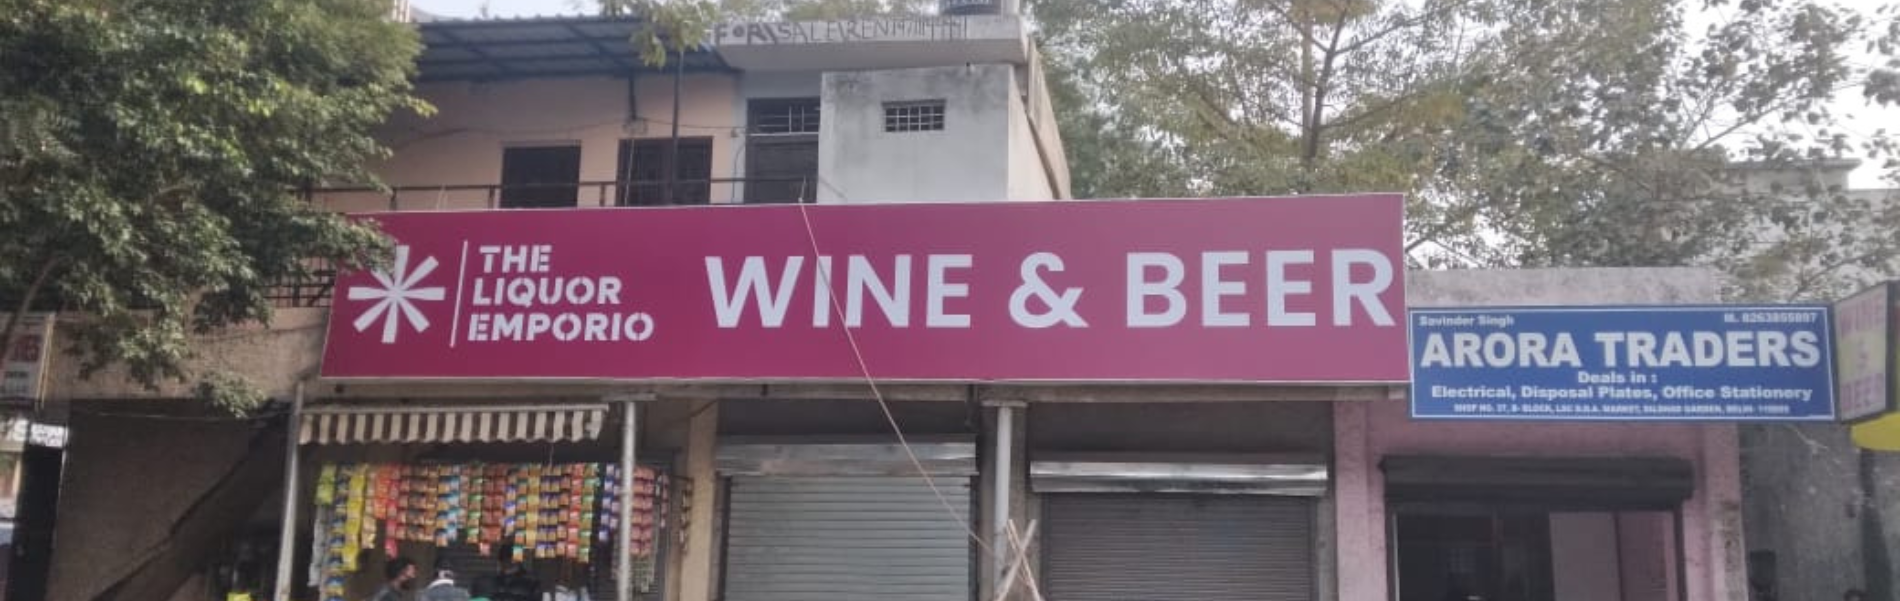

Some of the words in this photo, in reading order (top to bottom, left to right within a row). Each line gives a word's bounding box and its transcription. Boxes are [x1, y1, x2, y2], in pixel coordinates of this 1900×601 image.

[479, 245, 552, 273] THE
[473, 276, 622, 308] LIQUOR
[704, 254, 973, 328] WINE
[1008, 252, 1089, 328] &
[1126, 249, 1396, 327] BEER
[468, 312, 654, 341] EMPORIO
[1420, 332, 1582, 368] ARORA
[1594, 330, 1821, 368] TRADERS
[1578, 371, 1626, 384] Deals
[1630, 371, 1646, 383] in
[1432, 385, 1517, 400] Electrical,
[1521, 386, 1593, 400] Disposal
[1598, 386, 1658, 400] Plates,
[1662, 386, 1715, 399] Office
[1720, 386, 1813, 401] Stationery
